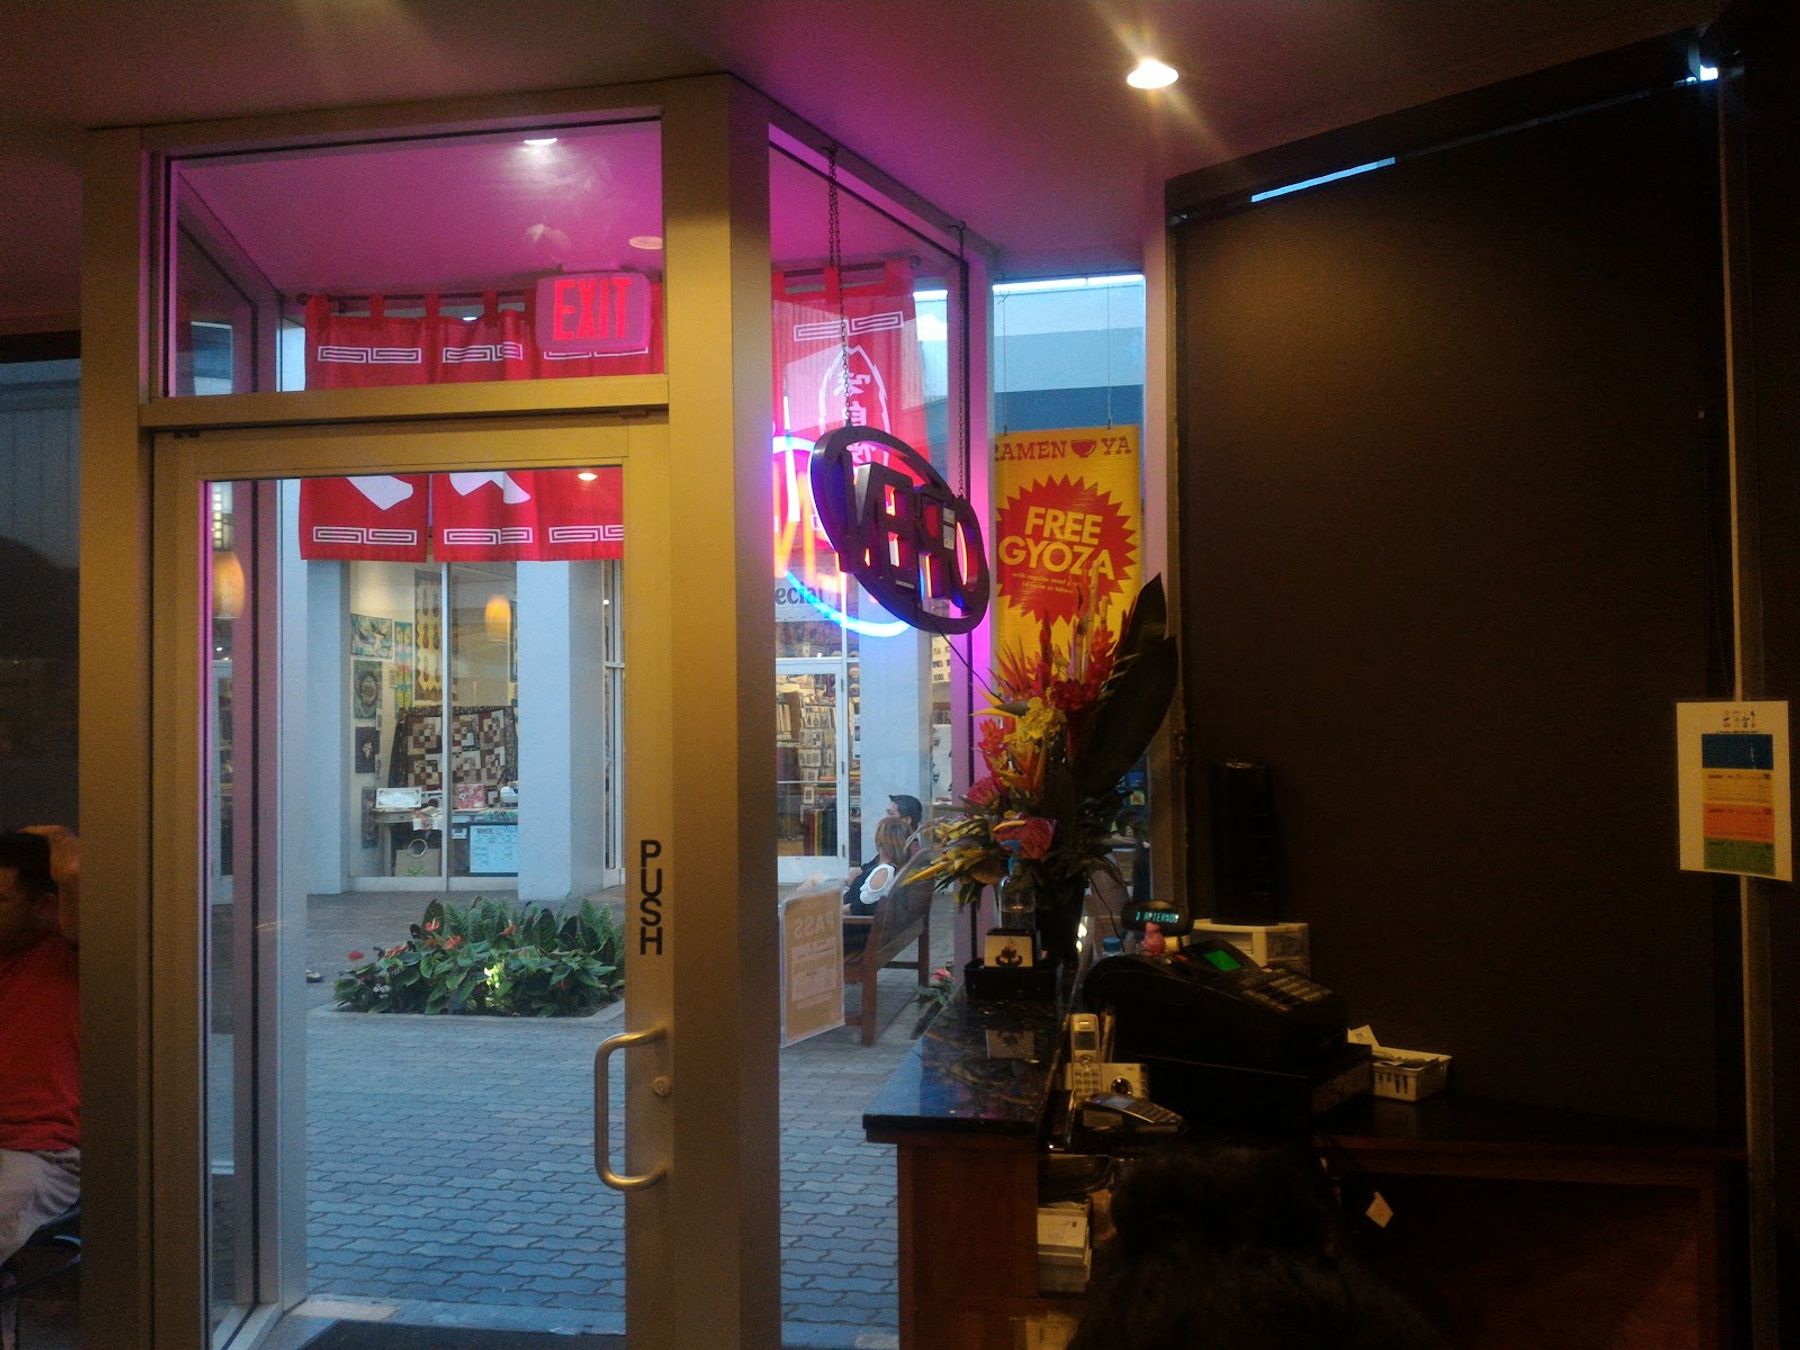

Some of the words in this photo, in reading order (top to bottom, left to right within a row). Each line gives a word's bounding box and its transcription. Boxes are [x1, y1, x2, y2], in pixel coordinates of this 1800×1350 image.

[553, 276, 633, 340] EXIT
[1101, 435, 1132, 455] YA
[1025, 506, 1103, 545] FREE
[998, 535, 1115, 580] GYOZA
[640, 839, 662, 955] PUSH
